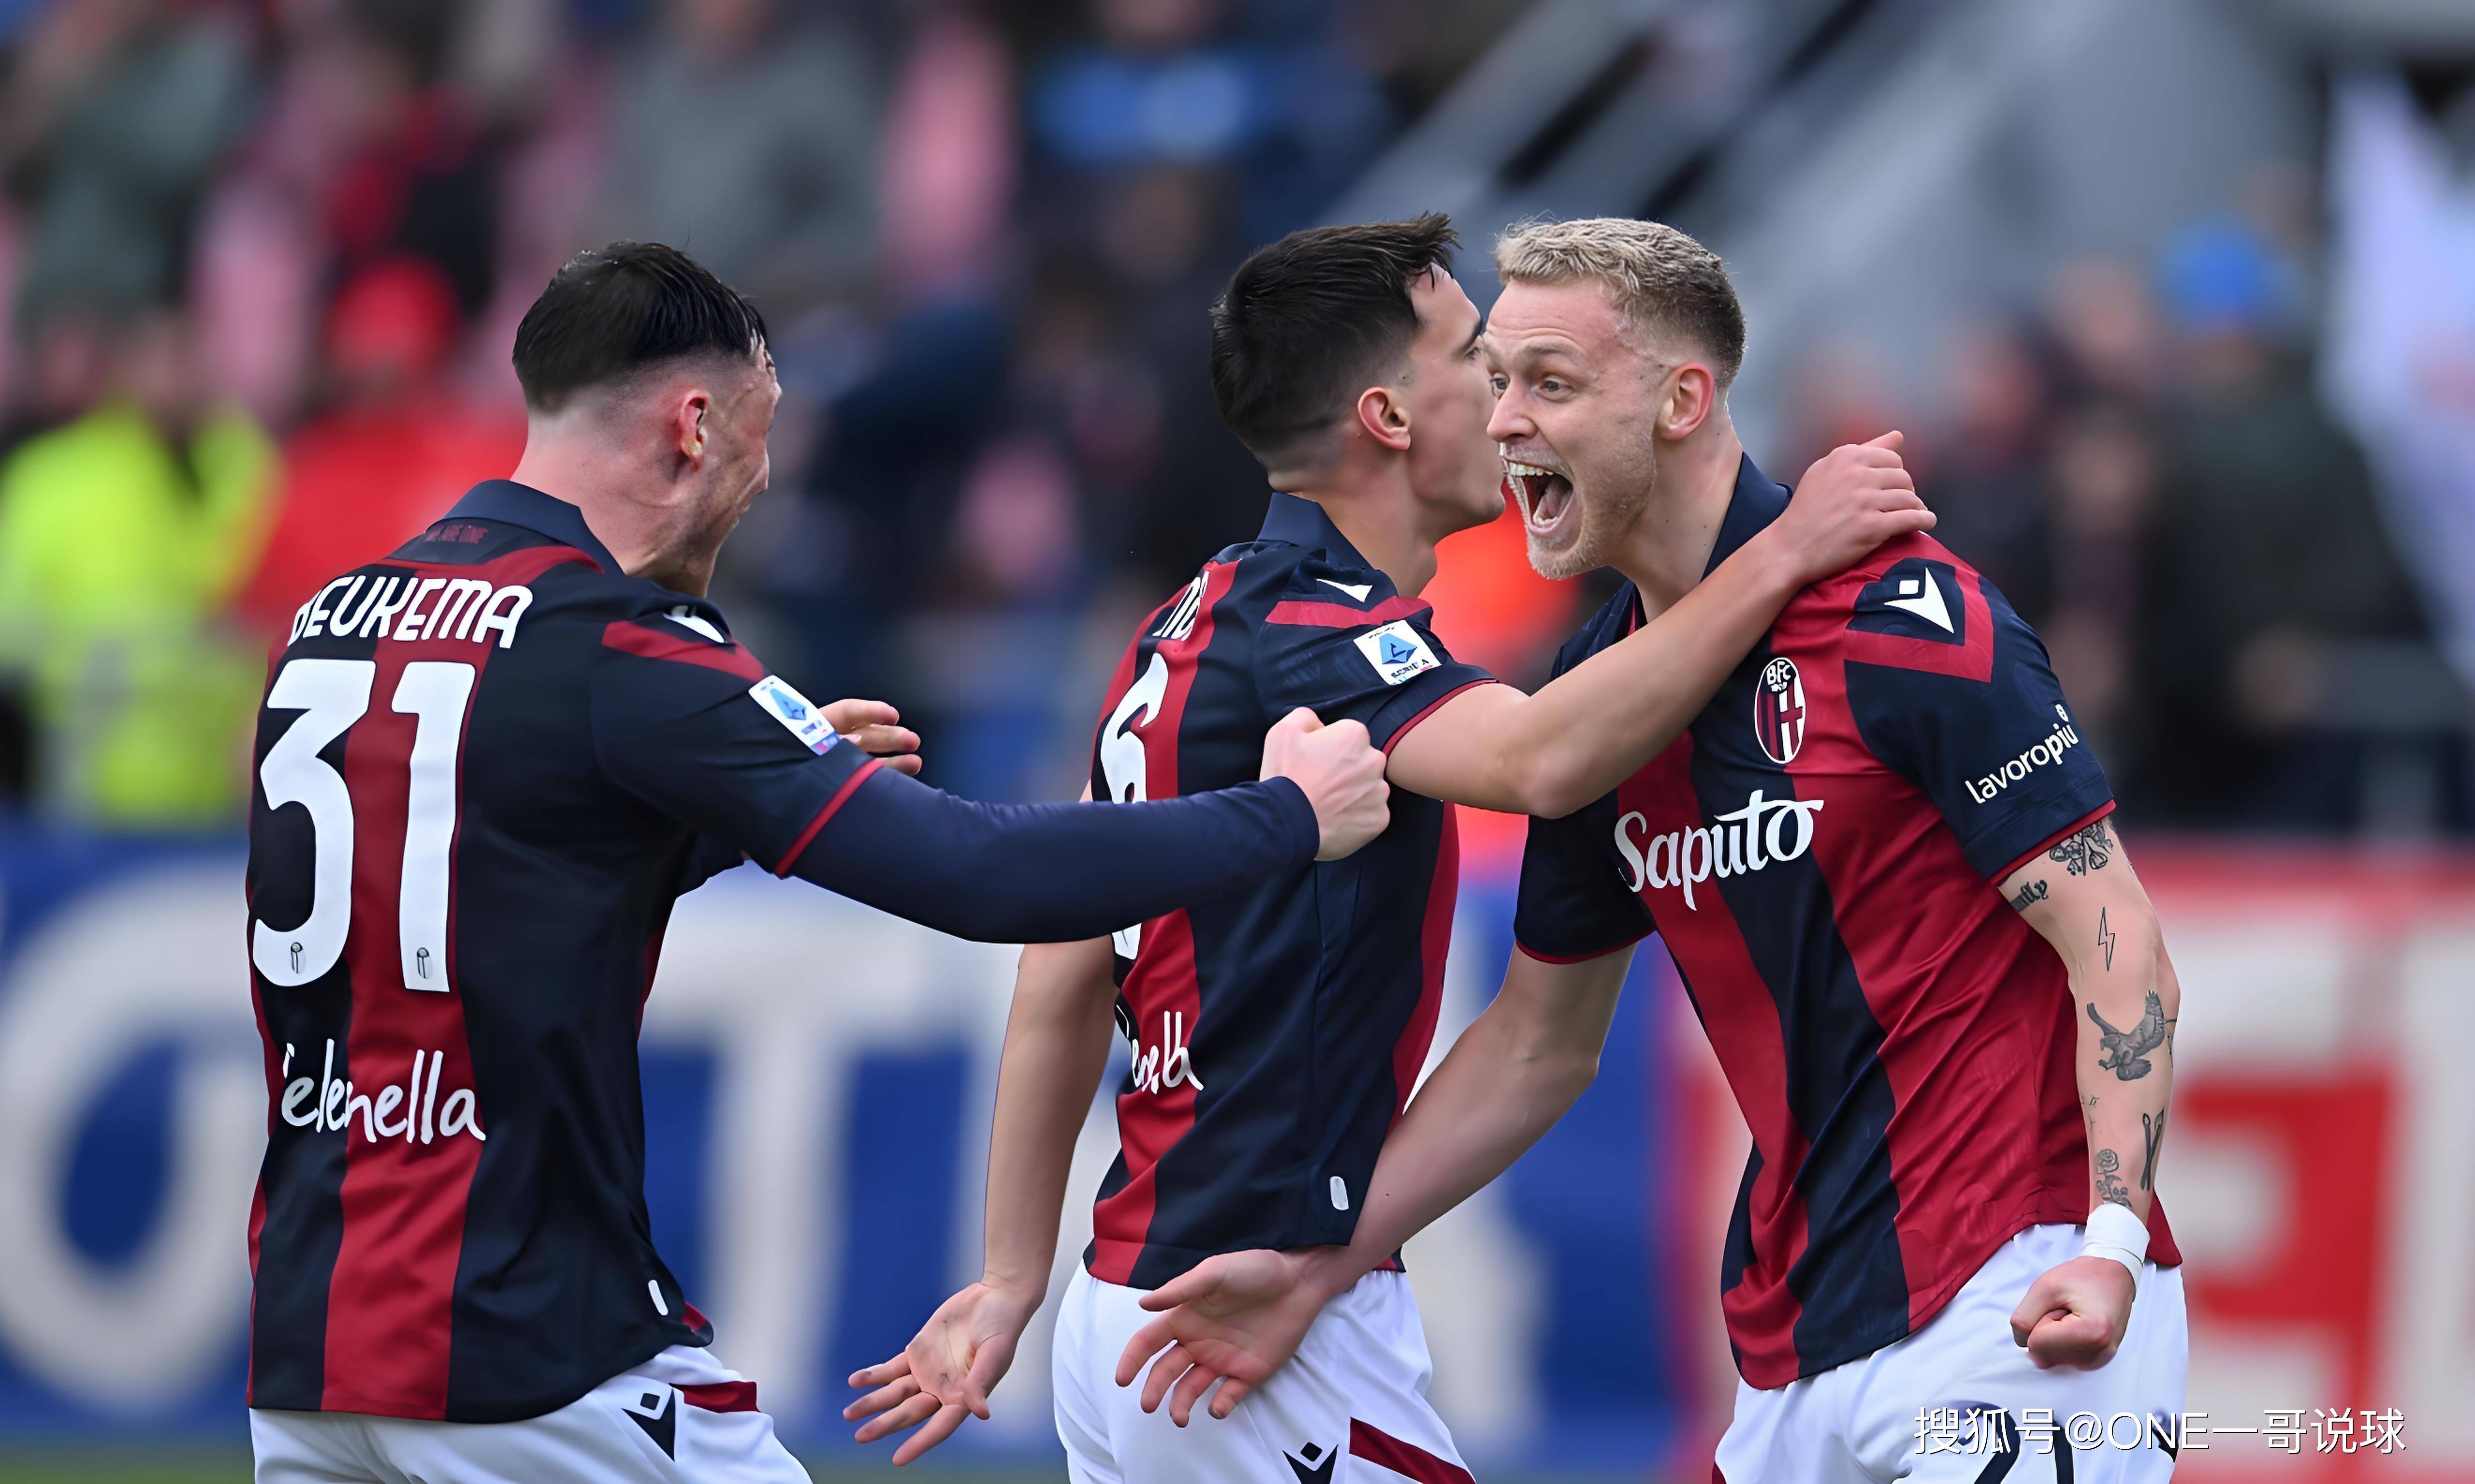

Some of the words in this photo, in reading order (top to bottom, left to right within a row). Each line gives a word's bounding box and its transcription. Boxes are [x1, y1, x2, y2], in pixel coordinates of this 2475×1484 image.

[1767, 661, 1791, 685] BFC
[253, 658, 476, 992] 31
[1614, 789, 1824, 911] Saputo
